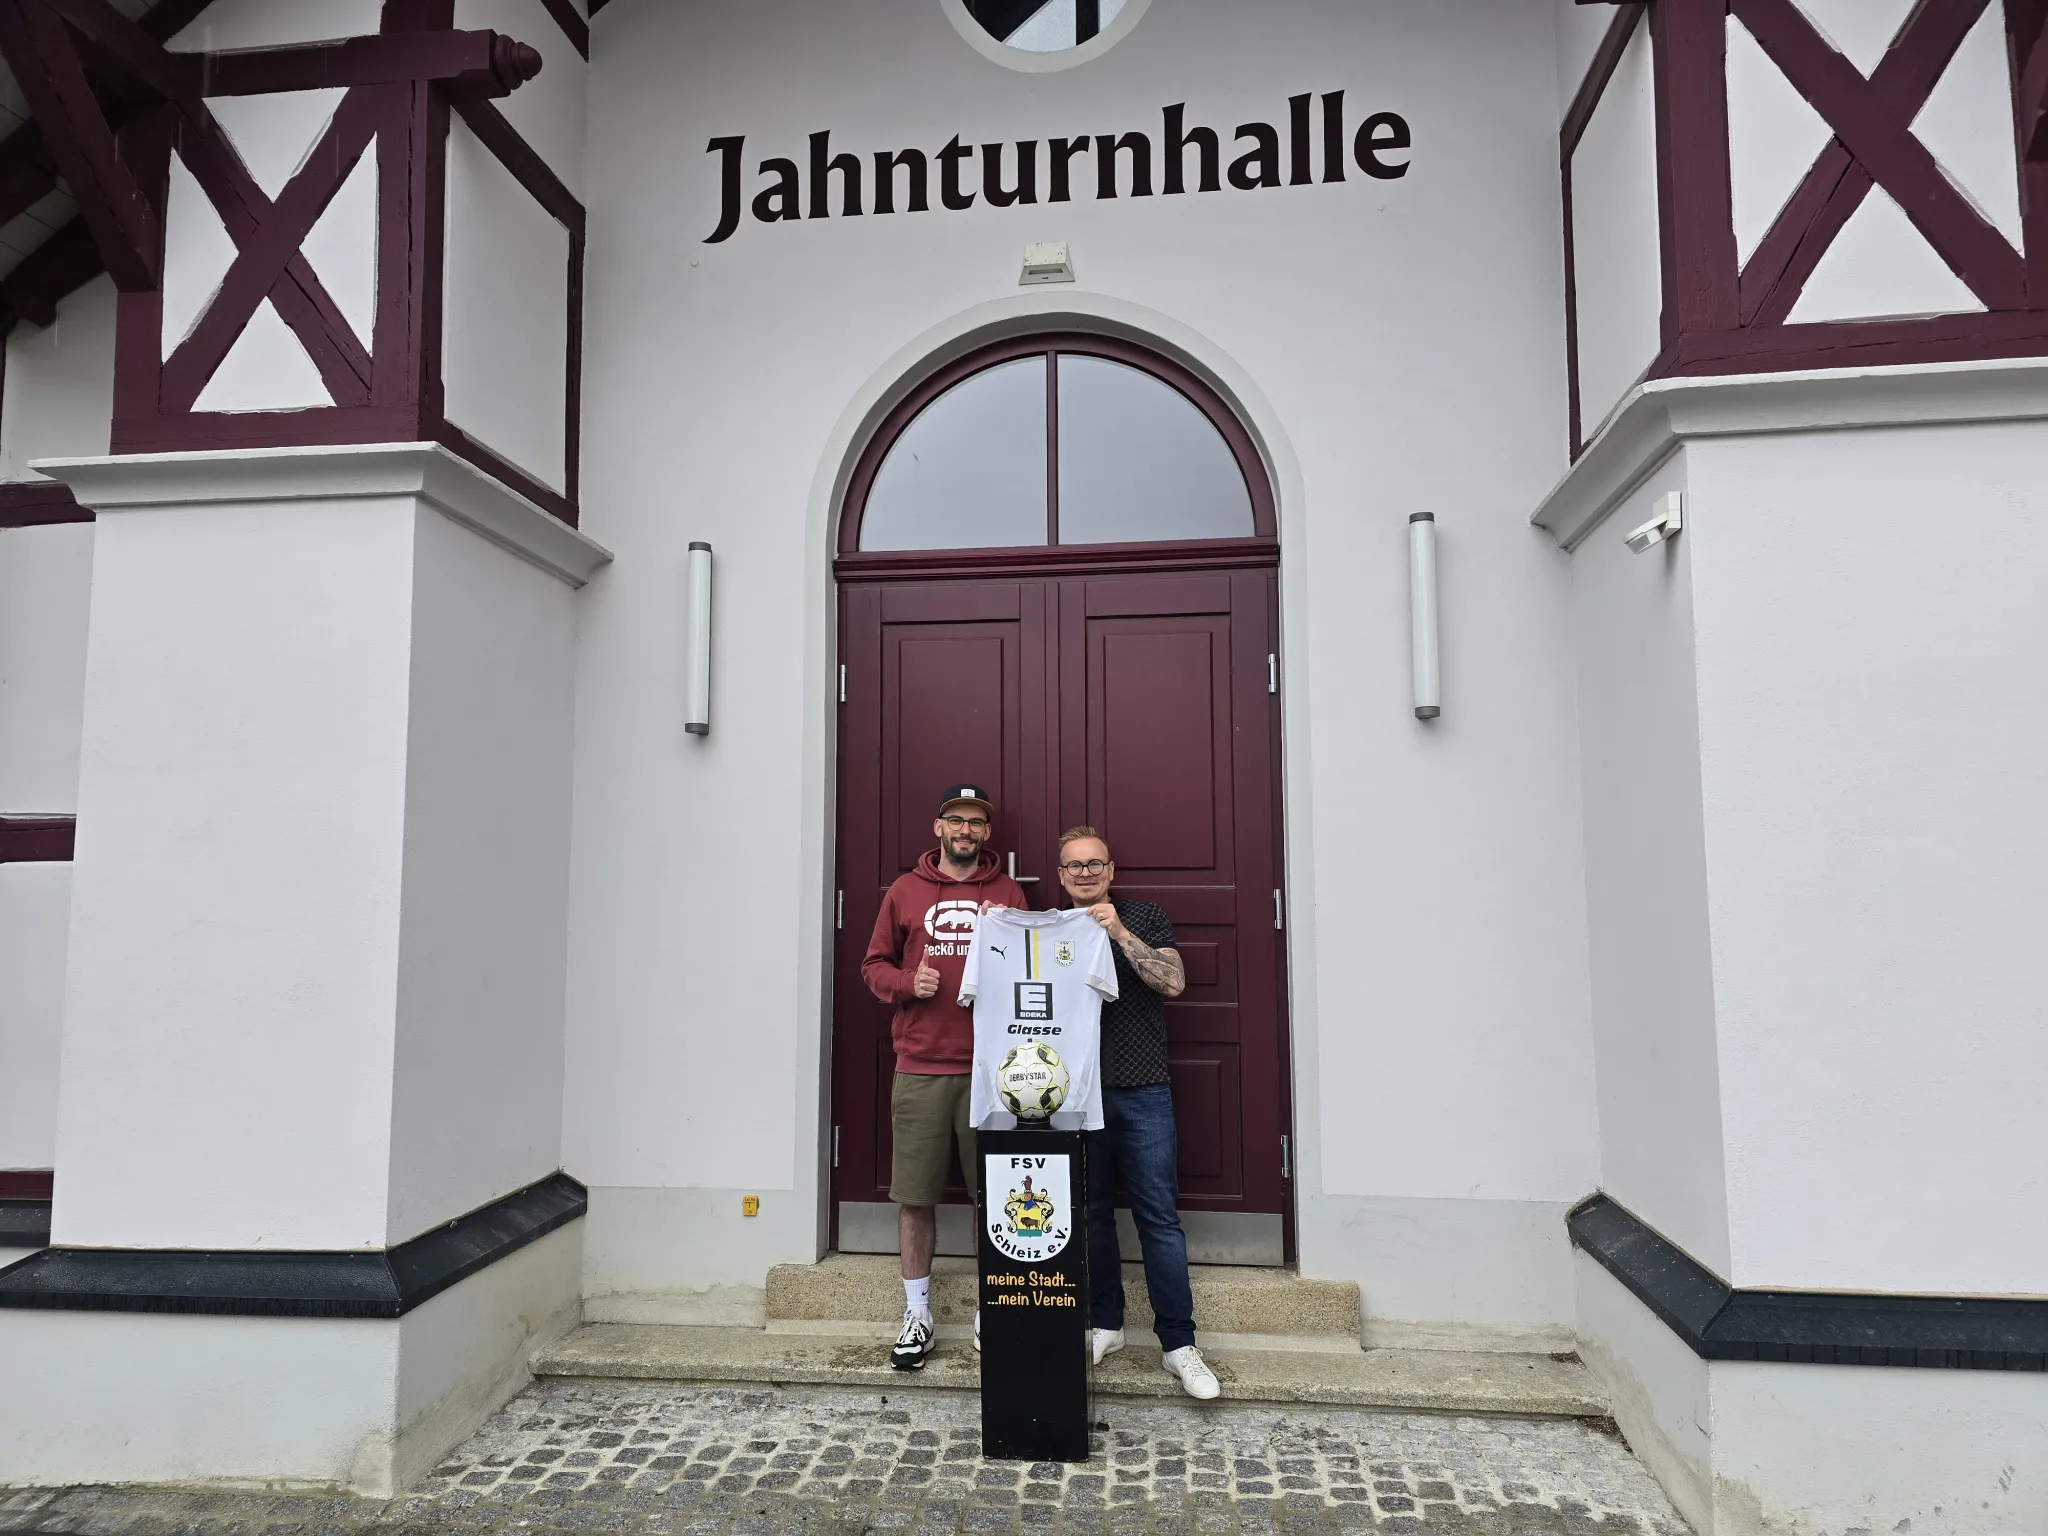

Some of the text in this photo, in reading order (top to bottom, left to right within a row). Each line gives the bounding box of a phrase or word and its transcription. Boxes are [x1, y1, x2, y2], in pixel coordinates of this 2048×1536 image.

[700, 89, 1412, 244] Jahnturnhalle
[1007, 1024, 1062, 1036] Glasse
[1009, 1072, 1047, 1083] DERBYSTAR
[1010, 1157, 1046, 1169] FSV
[991, 1223, 1069, 1259] Schleiz e.V.
[986, 1270, 1076, 1287] meine Stadt...
[987, 1290, 1076, 1307] ...mein Verein
